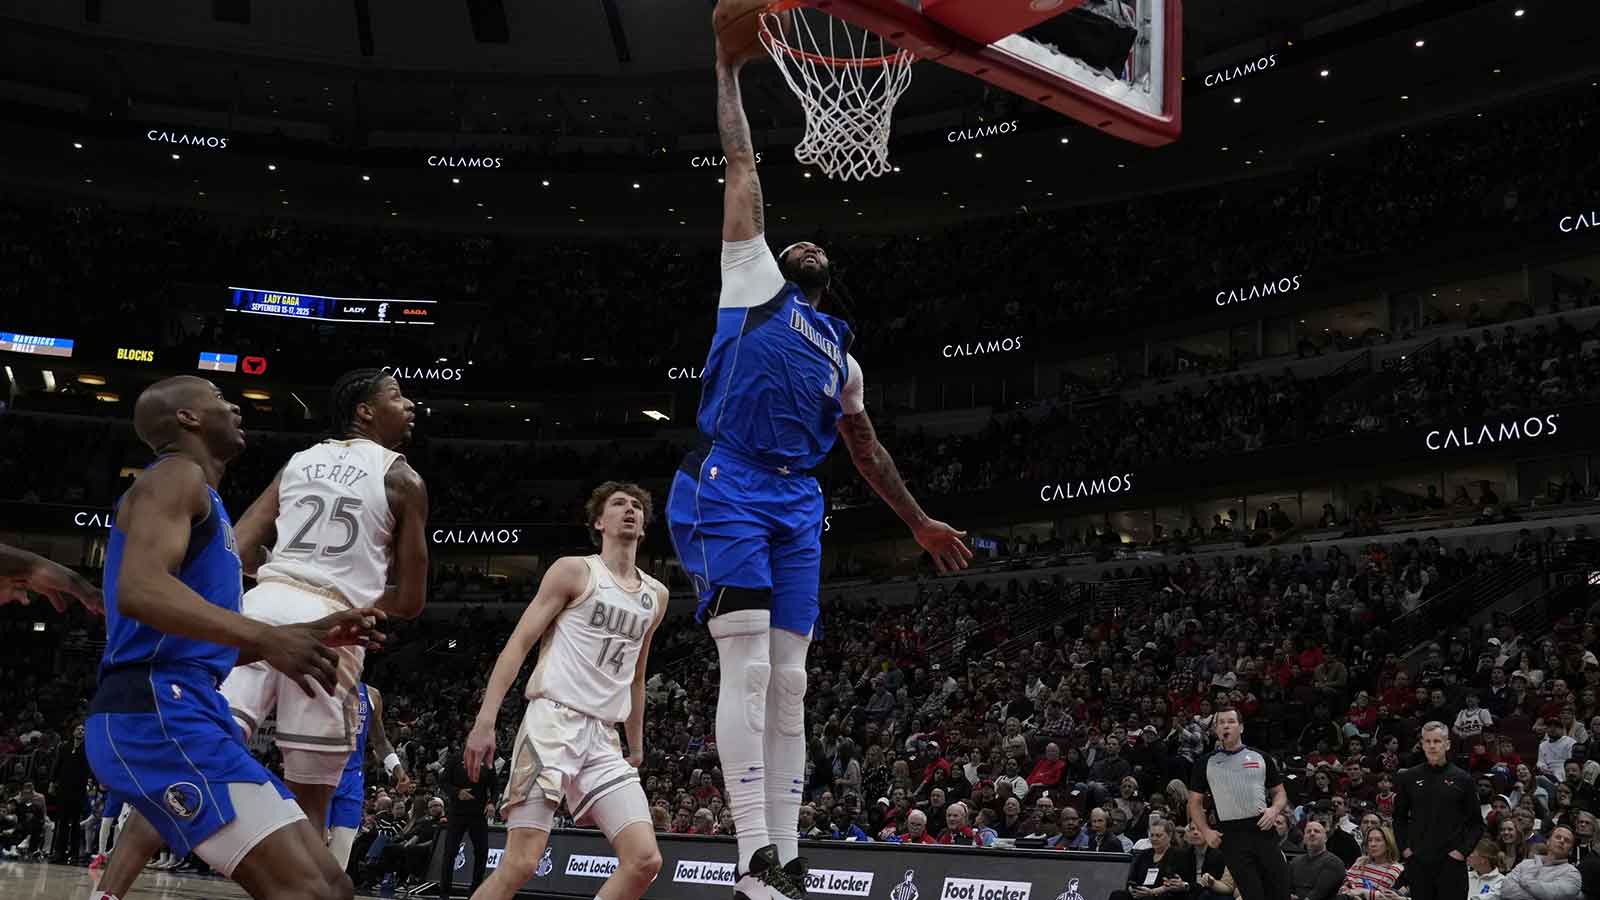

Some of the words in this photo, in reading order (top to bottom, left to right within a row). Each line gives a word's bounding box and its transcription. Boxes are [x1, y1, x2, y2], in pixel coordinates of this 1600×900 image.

[1204, 54, 1276, 87] CALAMOS
[147, 130, 228, 149] CALAMOS
[947, 119, 1018, 143] CALAMOS
[427, 155, 503, 169] CALAMOS
[691, 152, 762, 168] CALAS
[263, 293, 280, 304] LADY
[281, 295, 300, 306] GAGA
[1215, 274, 1302, 306] CALAMOS
[116, 347, 154, 362] BLOCKS
[942, 335, 1023, 358] CALAMOS
[1425, 413, 1560, 451] CALAMOS
[302, 463, 368, 487] TERRY
[1040, 473, 1134, 502] CALAMOS
[281, 494, 363, 557] 25
[432, 528, 522, 544] CALAMOS
[589, 601, 648, 641] BULLS
[595, 637, 626, 675] 14
[568, 858, 588, 873] Foot
[589, 859, 617, 875] Locke
[676, 864, 699, 879] Foot
[804, 872, 825, 885] oot
[827, 873, 870, 892] Locker
[945, 882, 974, 900] Foot
[978, 884, 1027, 900] Locker
